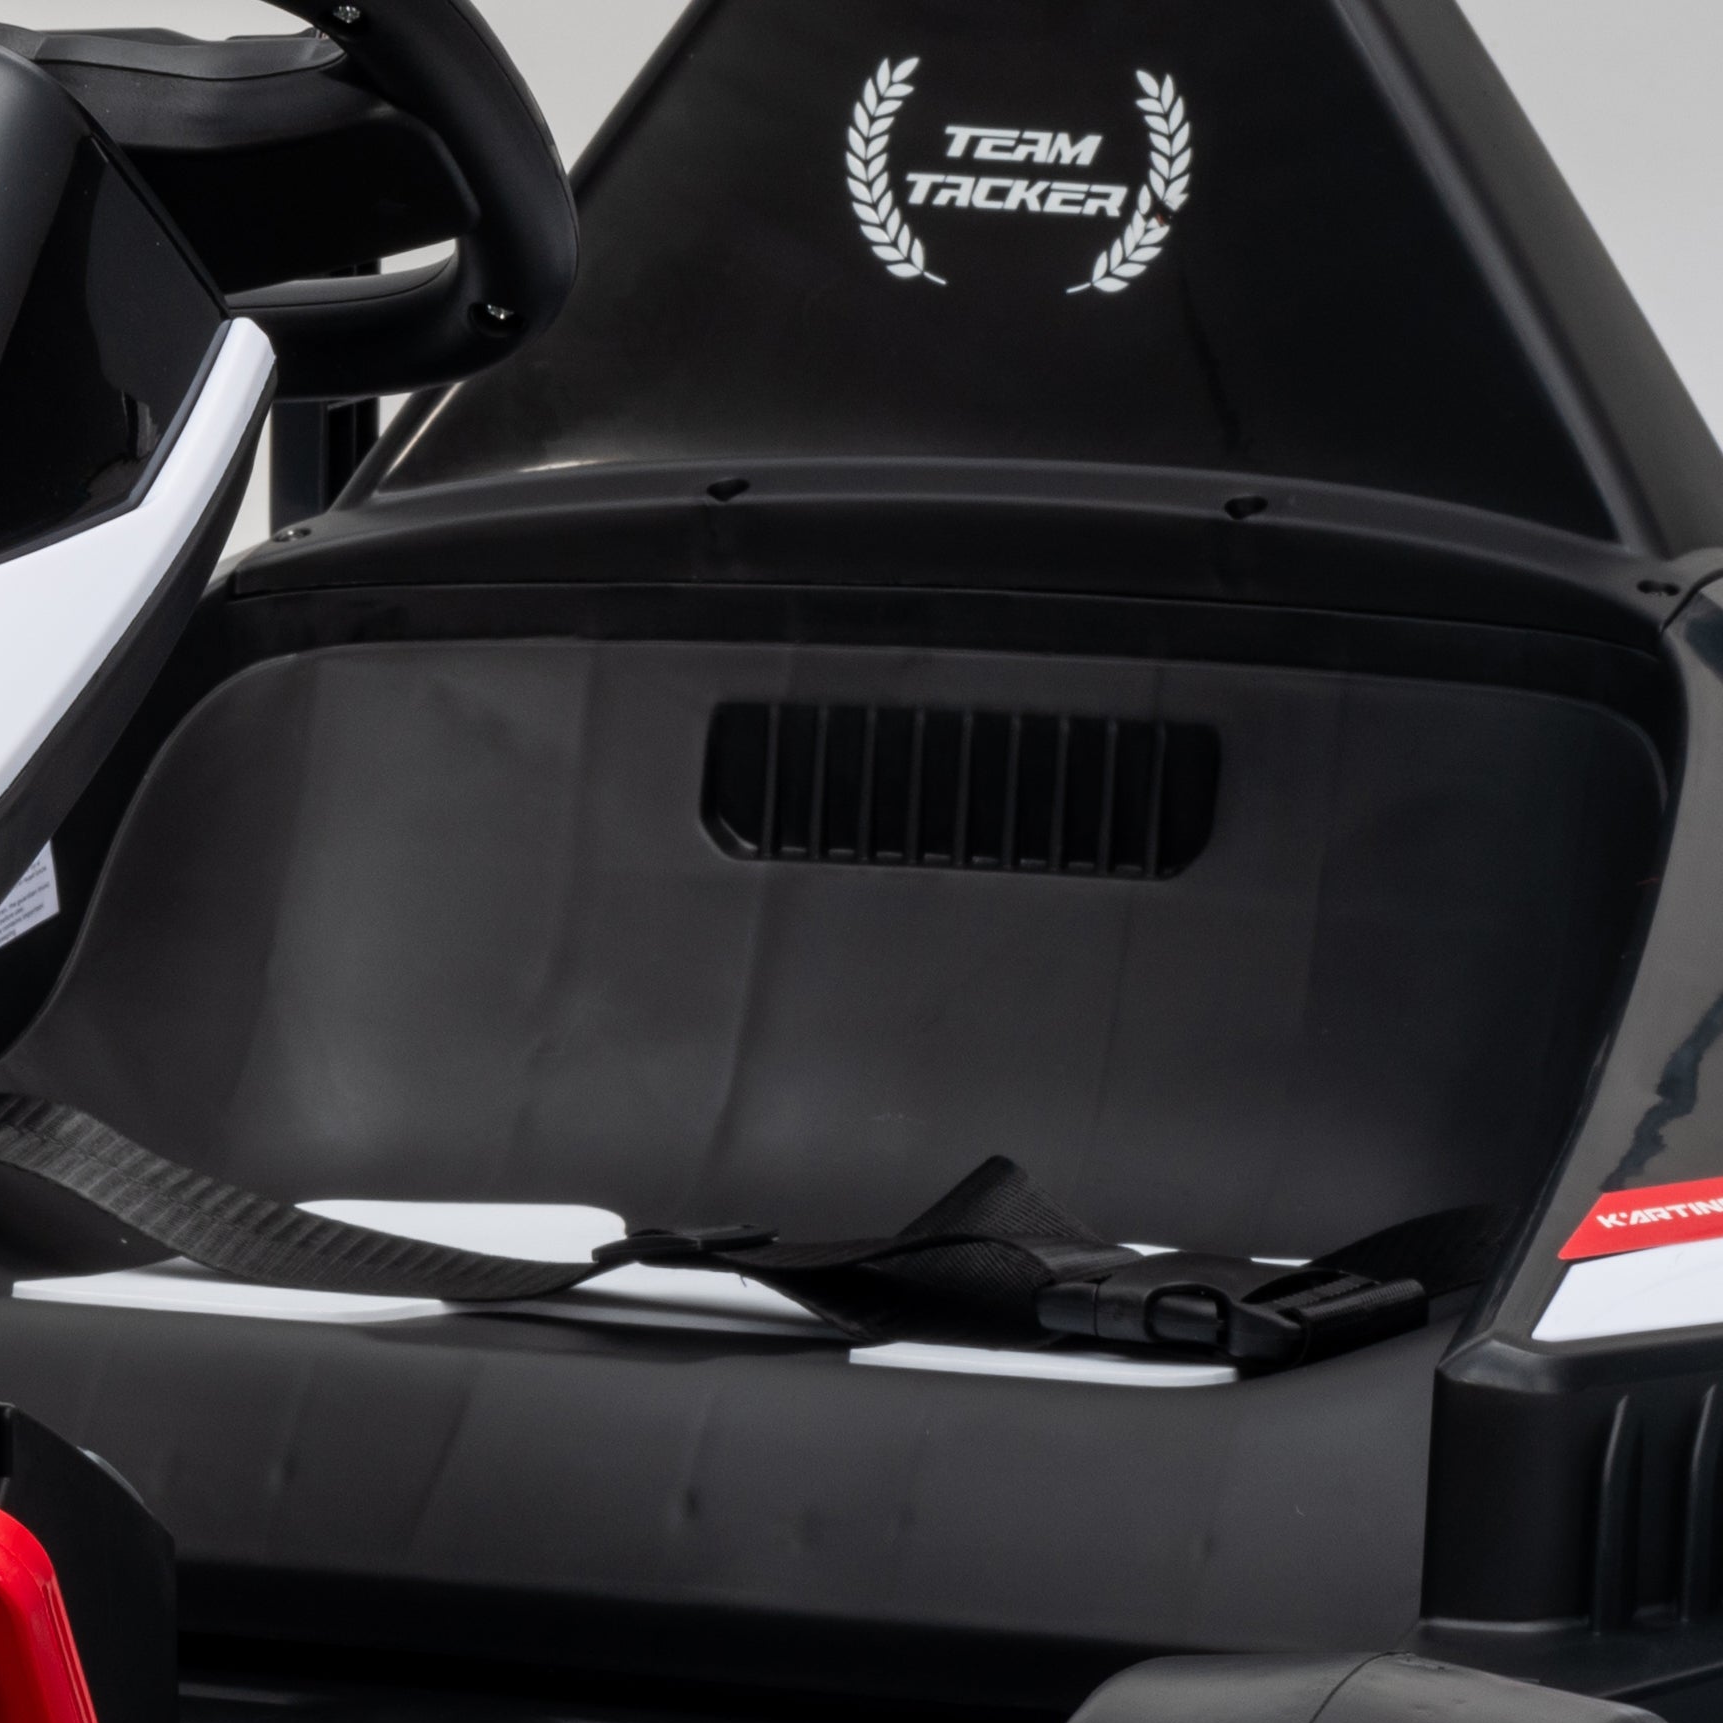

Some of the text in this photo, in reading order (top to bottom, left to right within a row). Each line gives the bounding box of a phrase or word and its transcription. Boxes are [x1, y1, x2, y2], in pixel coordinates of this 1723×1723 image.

[945, 125, 1103, 166] TEAM
[905, 172, 1128, 218] TACKER
[1596, 1198, 1723, 1229] K'ARTIN
